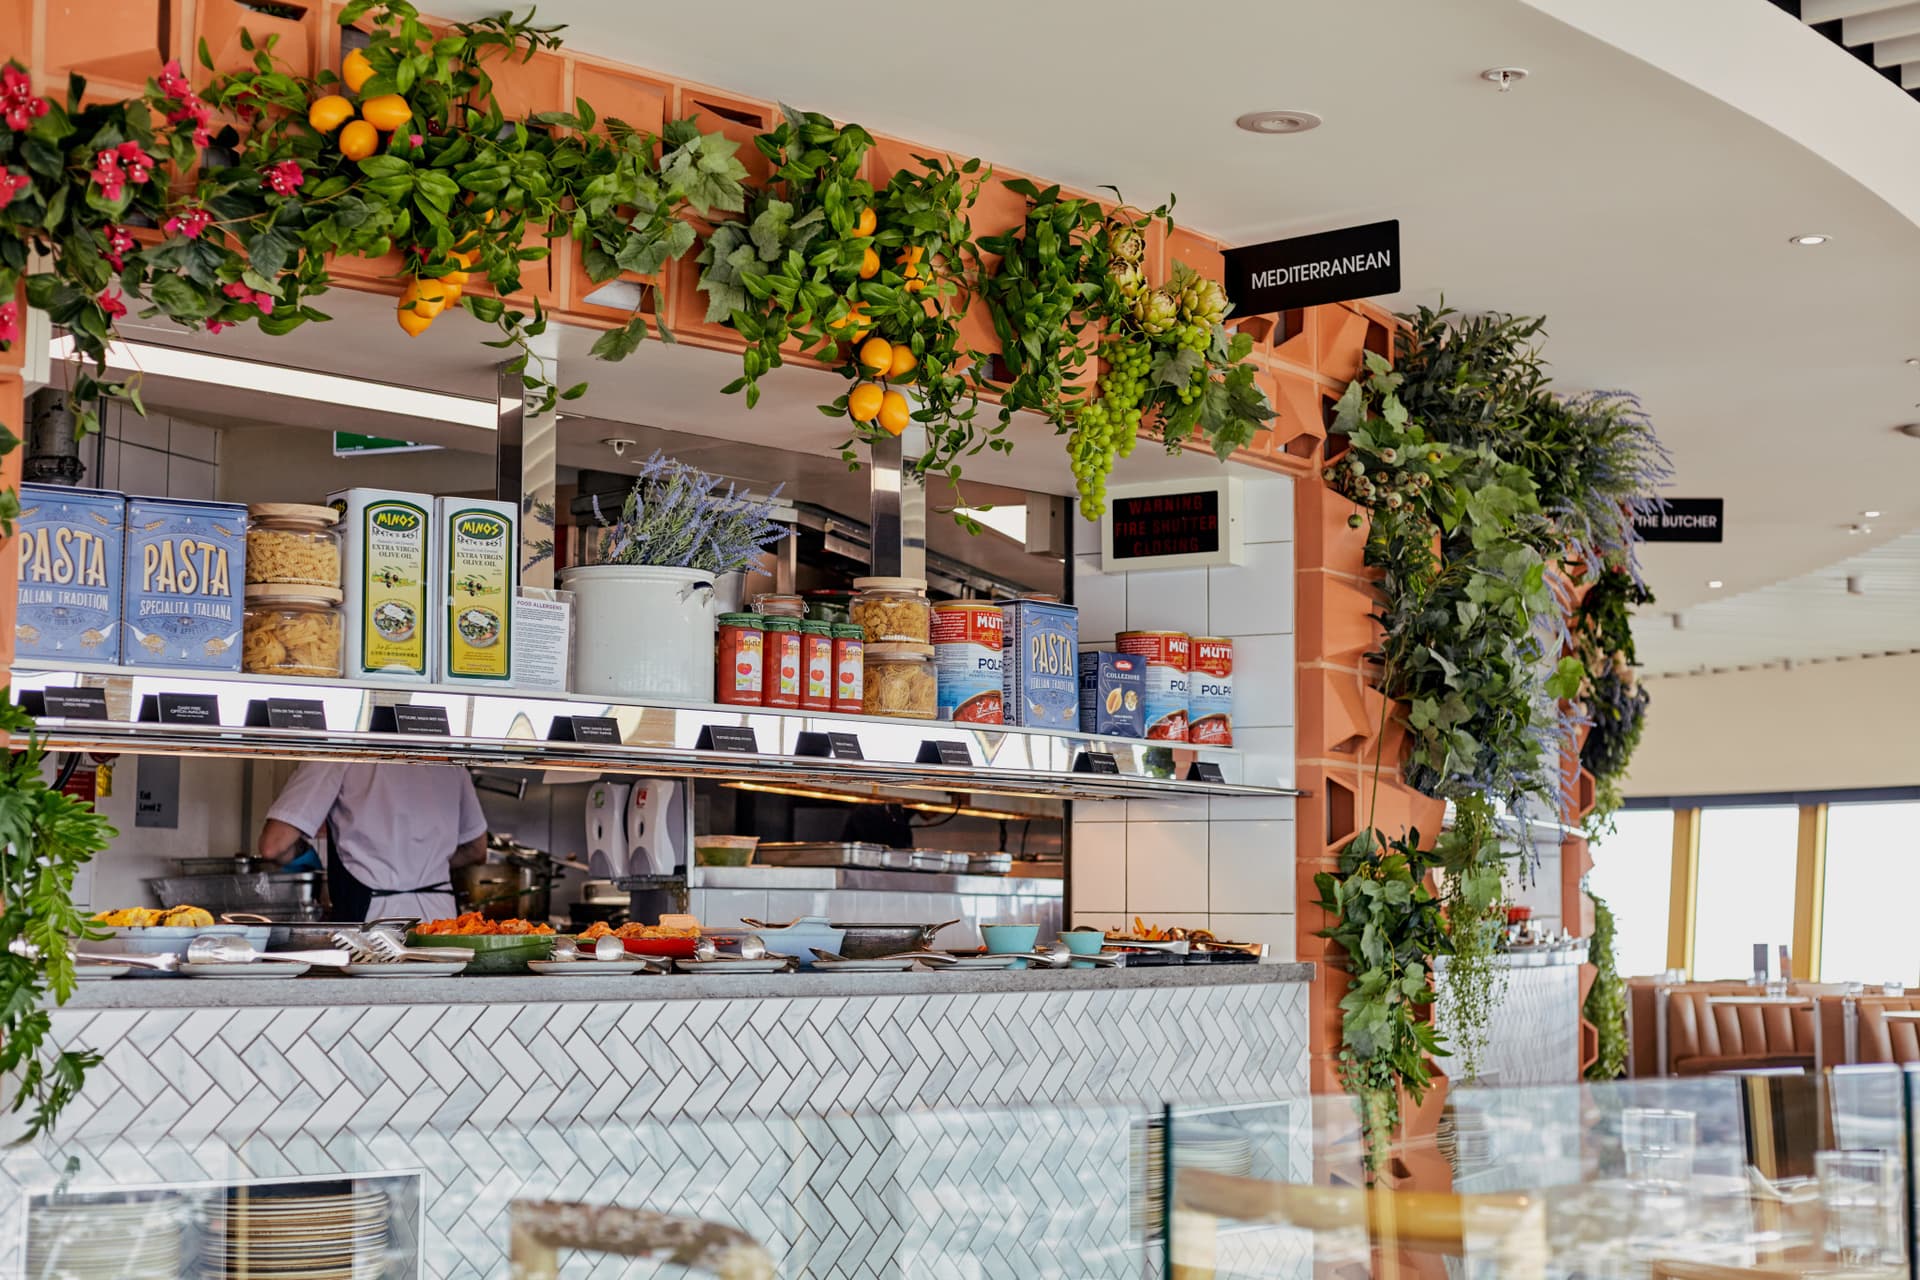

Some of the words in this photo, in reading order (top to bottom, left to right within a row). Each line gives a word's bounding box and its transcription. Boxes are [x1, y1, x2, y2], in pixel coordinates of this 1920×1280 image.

[1252, 250, 1391, 289] MEDITERRANEAN
[1128, 495, 1203, 515] WARNING
[377, 513, 416, 528] MINOS
[462, 521, 500, 536] MINOS
[1114, 521, 1146, 537] FIRE
[1152, 515, 1217, 535] SHUTTER
[1638, 515, 1659, 528] THE
[1661, 515, 1718, 528] BUTCHER
[372, 544, 395, 552] EXTRA
[396, 545, 420, 553] VIRGIN
[378, 551, 400, 559] OLIVE
[1133, 538, 1199, 556] CLOSING
[18, 527, 108, 588] PASTA
[457, 552, 478, 560] EXTRA
[480, 553, 504, 561] VIRGIN
[463, 559, 483, 567] OLIVE
[143, 538, 232, 597] PASTA
[18, 588, 52, 604] TALIAN
[58, 591, 110, 611] TRADITION
[533, 602, 562, 611] ALLERGENS
[140, 599, 190, 616] SPECIALITA
[193, 602, 232, 621] ITALIANA
[1032, 632, 1074, 677] PASTA
